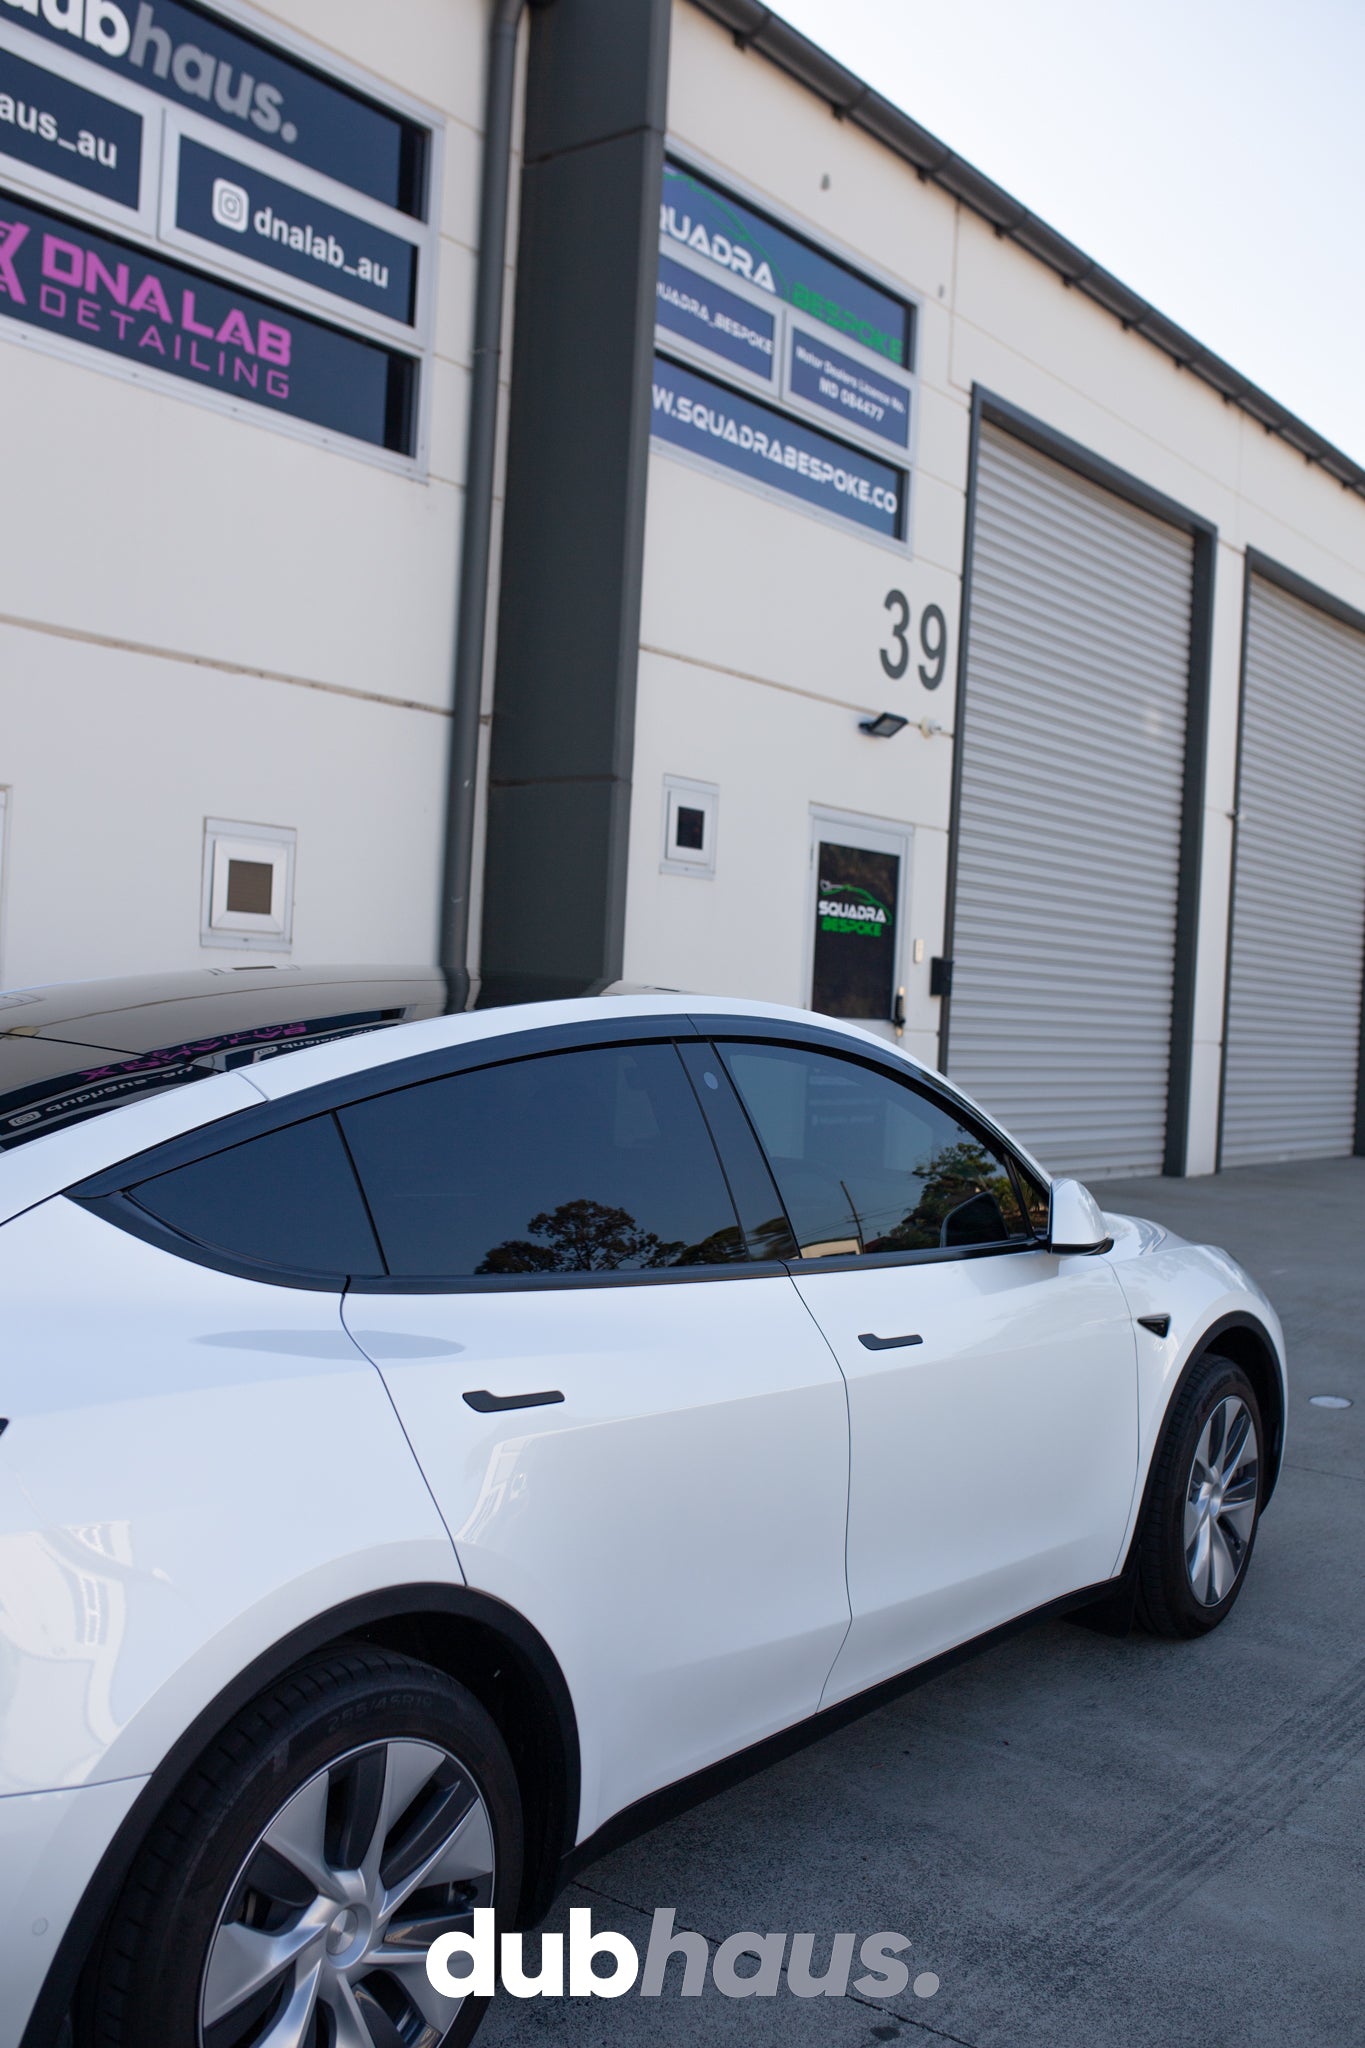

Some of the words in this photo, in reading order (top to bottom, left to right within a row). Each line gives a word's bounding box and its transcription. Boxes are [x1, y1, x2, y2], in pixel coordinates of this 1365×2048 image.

[0, 0, 298, 144] ubhaus.
[254, 207, 389, 289] dnalab_au
[40, 284, 290, 400] DETAILING
[792, 281, 904, 364] BESPOKE
[879, 589, 947, 690] 39
[819, 901, 887, 923] SQUADRA
[822, 916, 882, 937] BESPOKE
